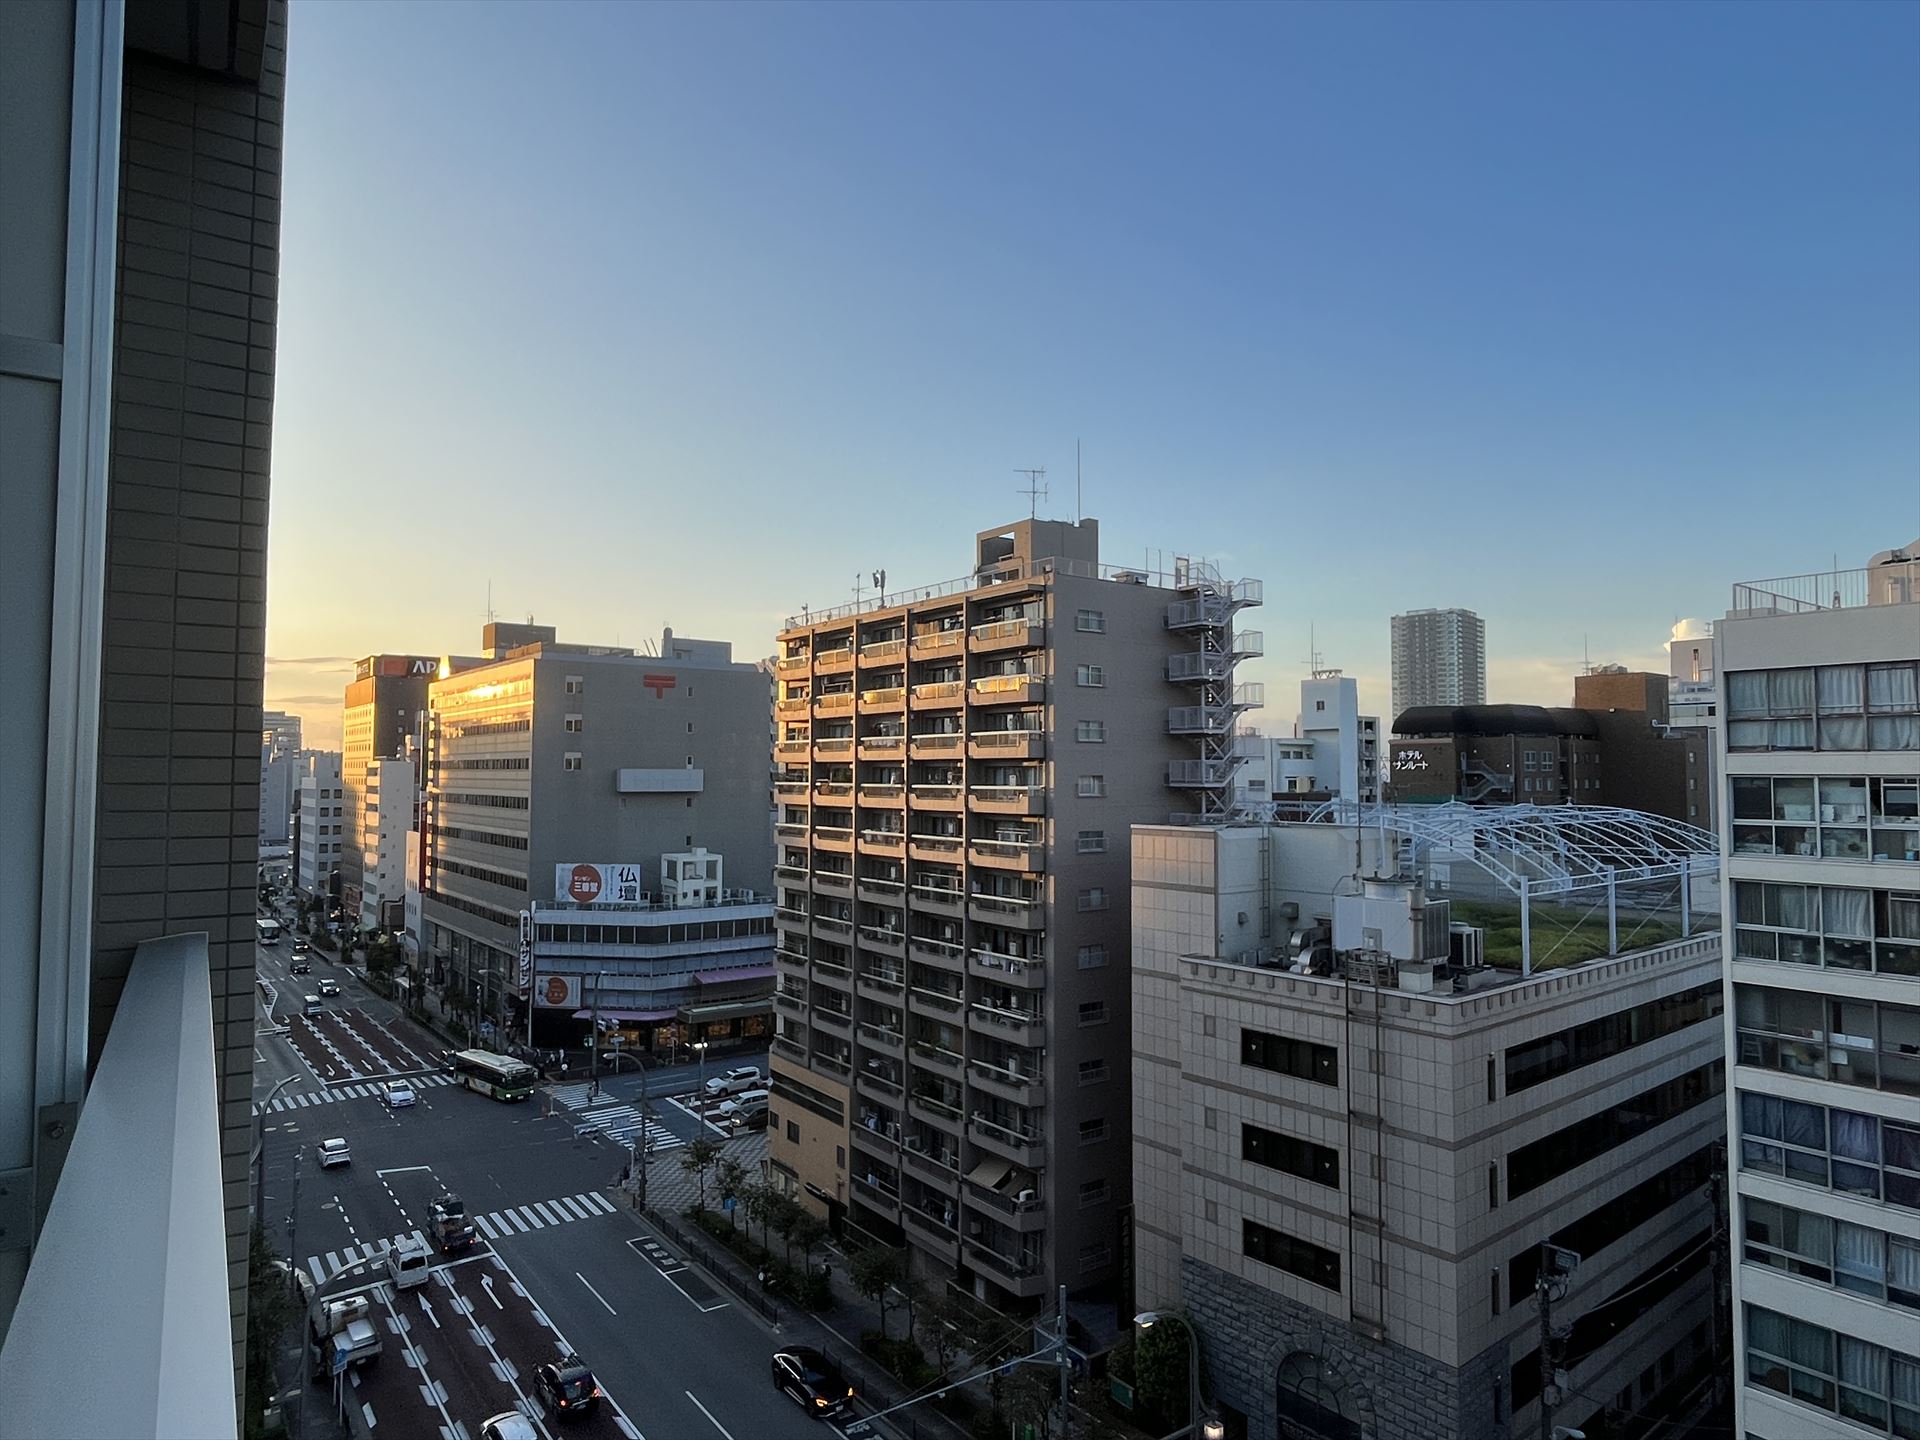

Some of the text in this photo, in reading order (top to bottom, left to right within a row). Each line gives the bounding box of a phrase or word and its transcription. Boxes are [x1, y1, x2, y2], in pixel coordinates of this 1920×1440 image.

[413, 660, 439, 673] AP
[1398, 750, 1423, 760] ホテル
[1392, 760, 1428, 770] サンルート
[618, 867, 637, 901] 仏壇
